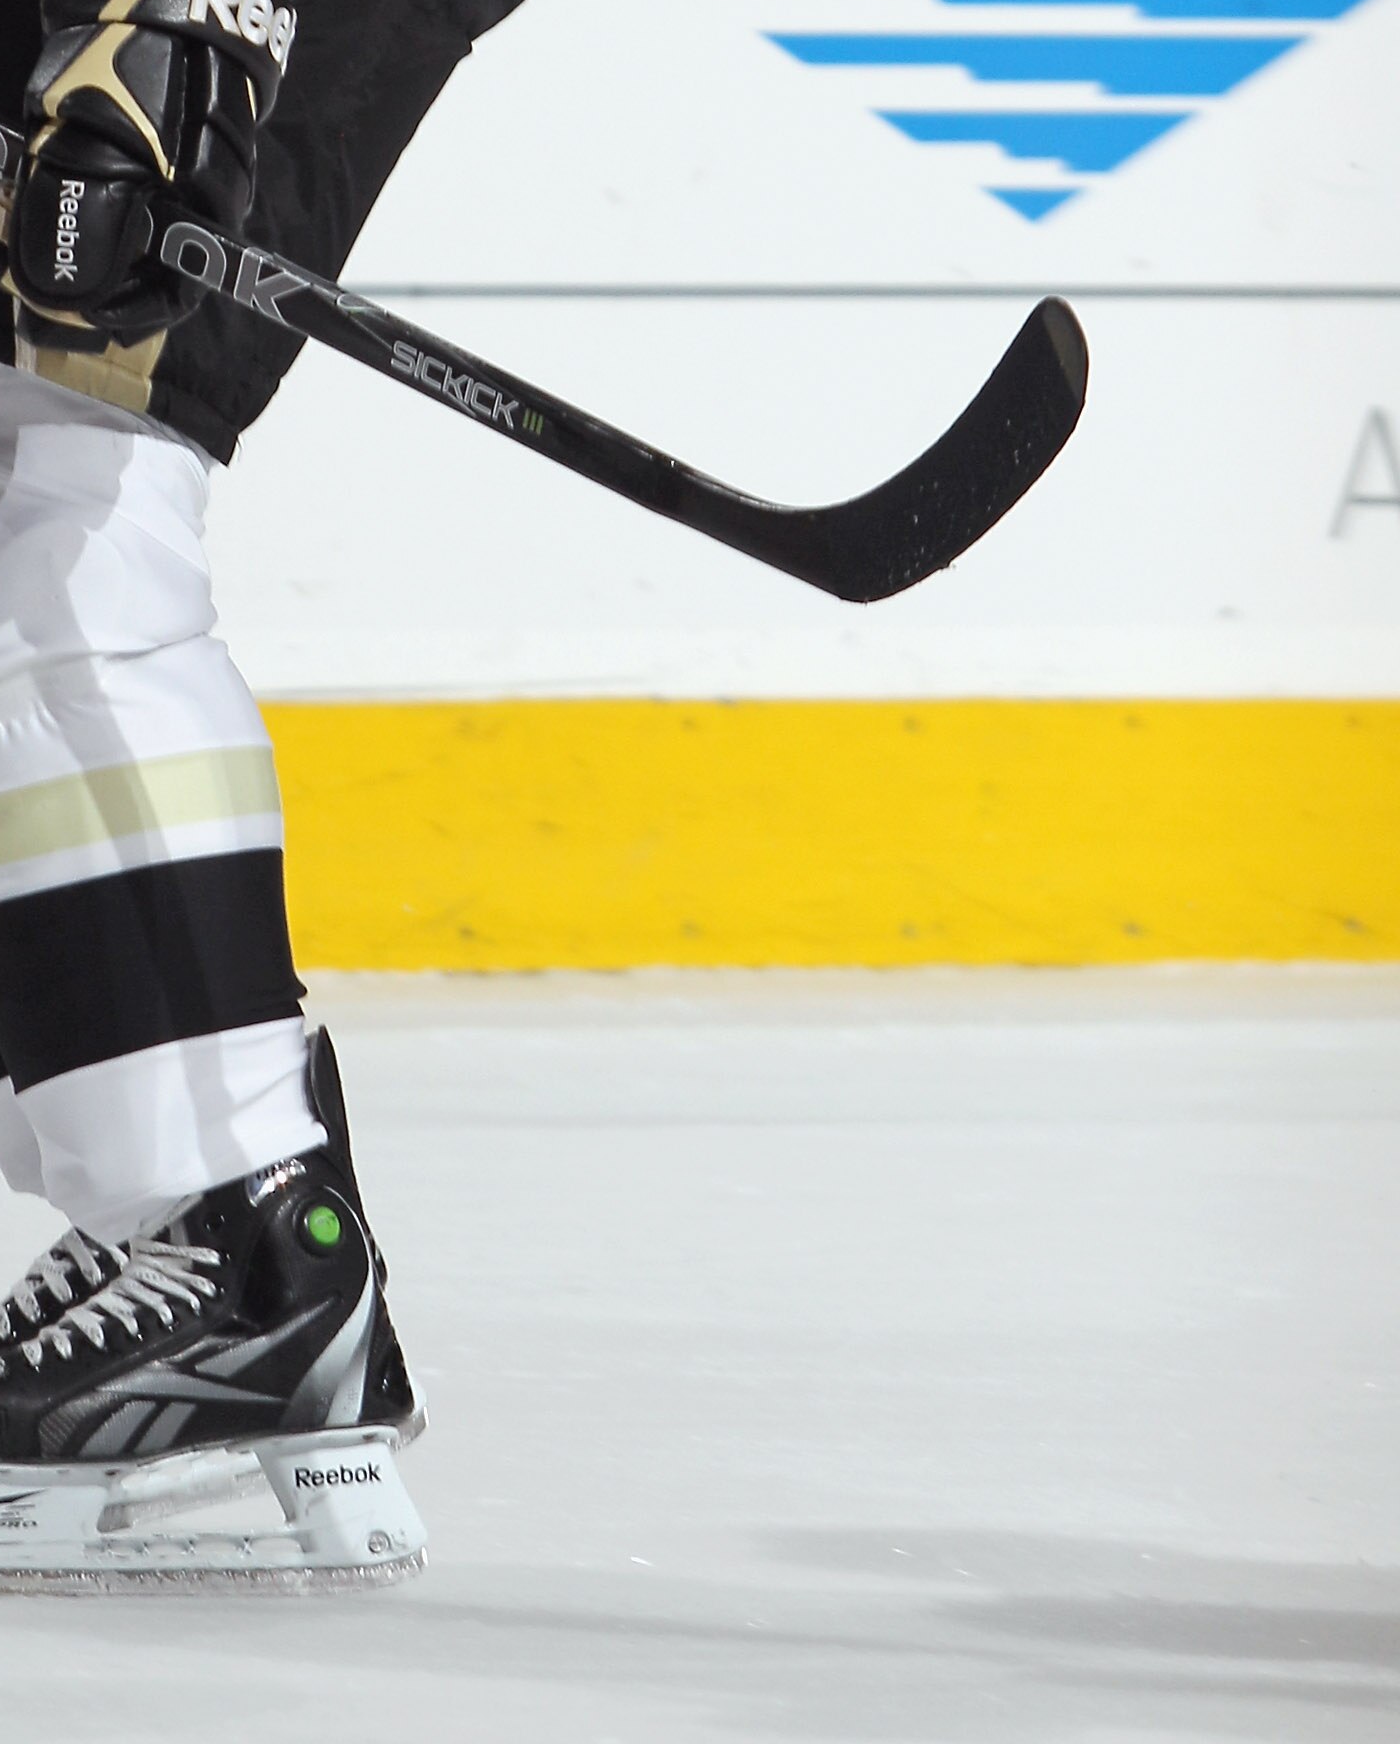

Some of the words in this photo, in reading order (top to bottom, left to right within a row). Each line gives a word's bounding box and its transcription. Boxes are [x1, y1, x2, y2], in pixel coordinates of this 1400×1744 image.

[53, 178, 86, 282] Reebok
[390, 339, 520, 430] SICKICK
[294, 1461, 382, 1489] Reebok
